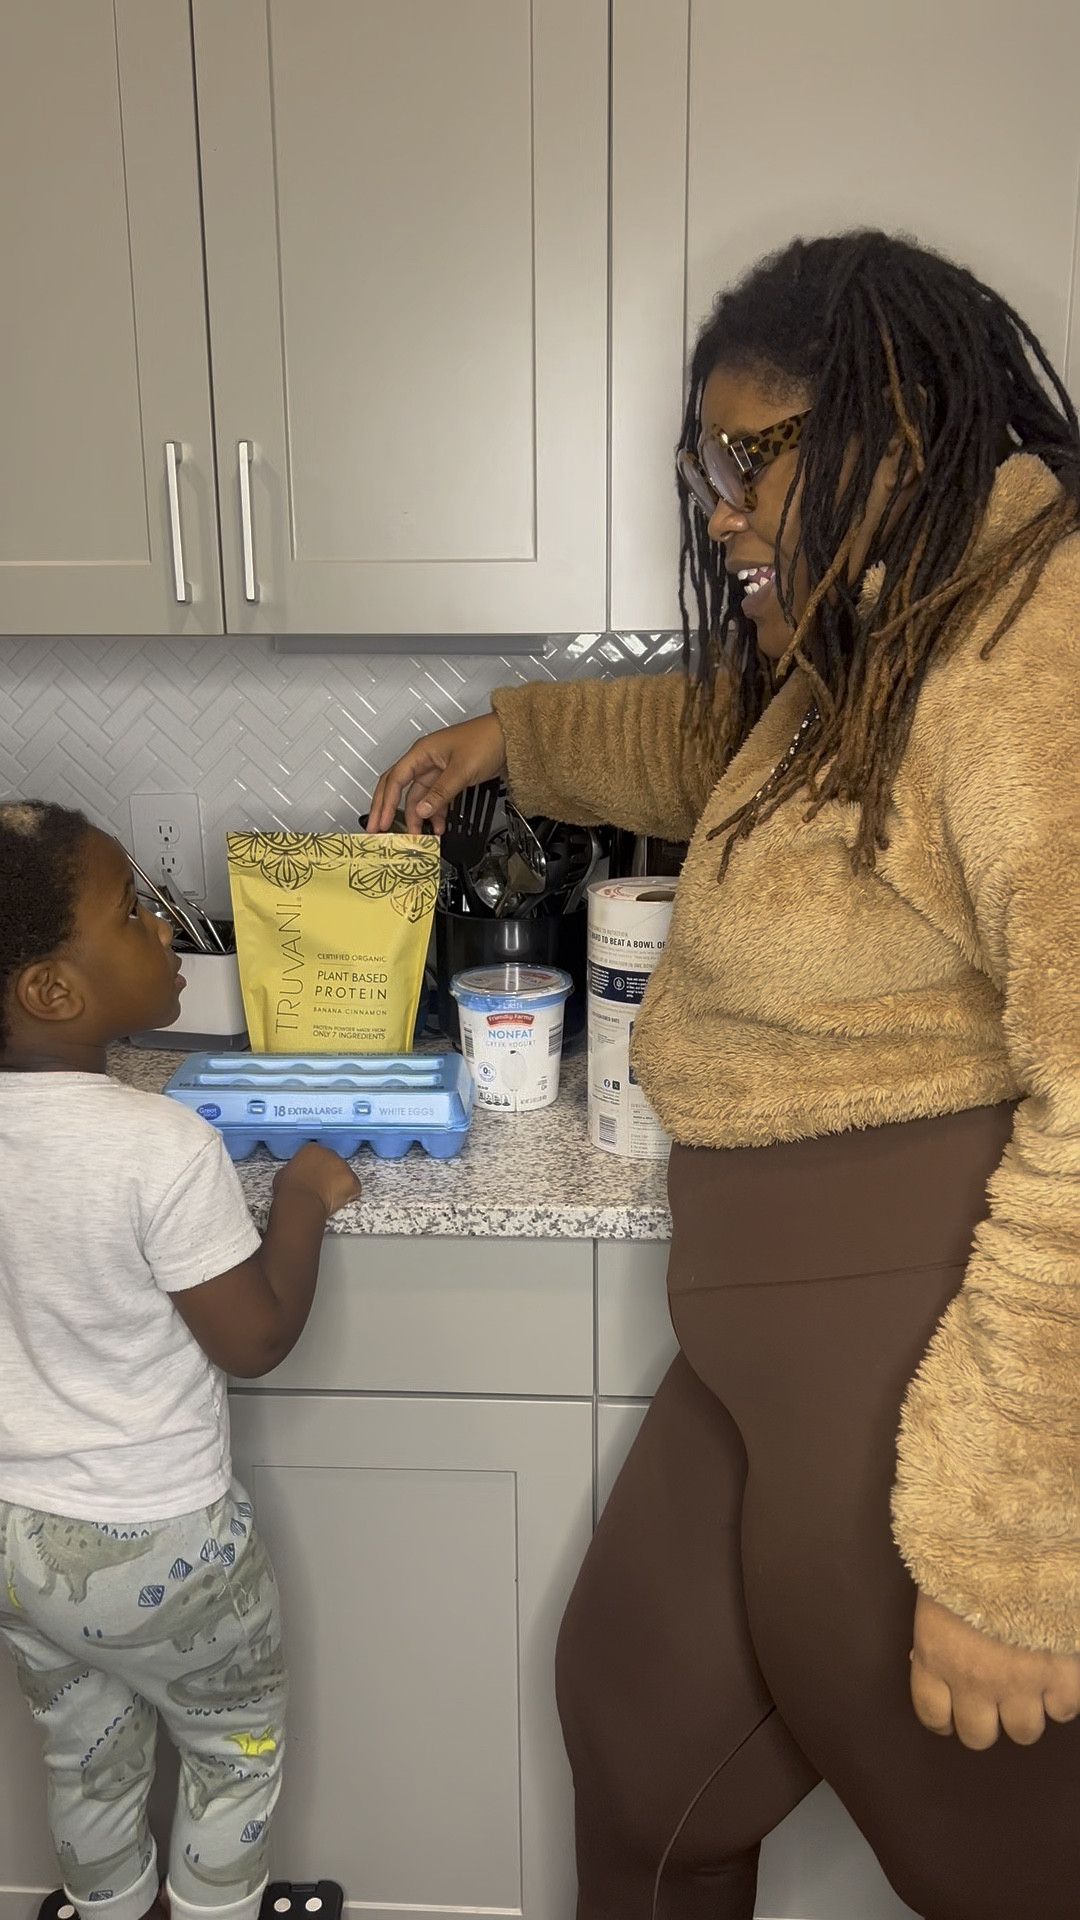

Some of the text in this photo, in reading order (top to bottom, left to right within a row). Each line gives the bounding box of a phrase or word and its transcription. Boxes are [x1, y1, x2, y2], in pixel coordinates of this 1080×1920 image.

[602, 935, 608, 944] TO
[610, 937, 625, 947] BEAT
[627, 940, 631, 948] A
[633, 940, 655, 949] BOWL
[657, 941, 666, 949] OF
[317, 953, 388, 962] CERTIFIED ORGANIC
[275, 903, 305, 1034] TRUVANI
[317, 970, 388, 984] PLANT BASED
[315, 985, 387, 1000] PROTEIN
[313, 1006, 387, 1016] BANANA CINNAMON
[312, 1030, 331, 1038] ONLY
[338, 1031, 386, 1040] INGREDIENTS
[488, 1029, 534, 1039] NONFAT
[509, 1040, 536, 1048] YOGURT
[199, 1107, 217, 1115] Great
[273, 1105, 434, 1117] 18 EXTRA LARGE WHITE EGGS
